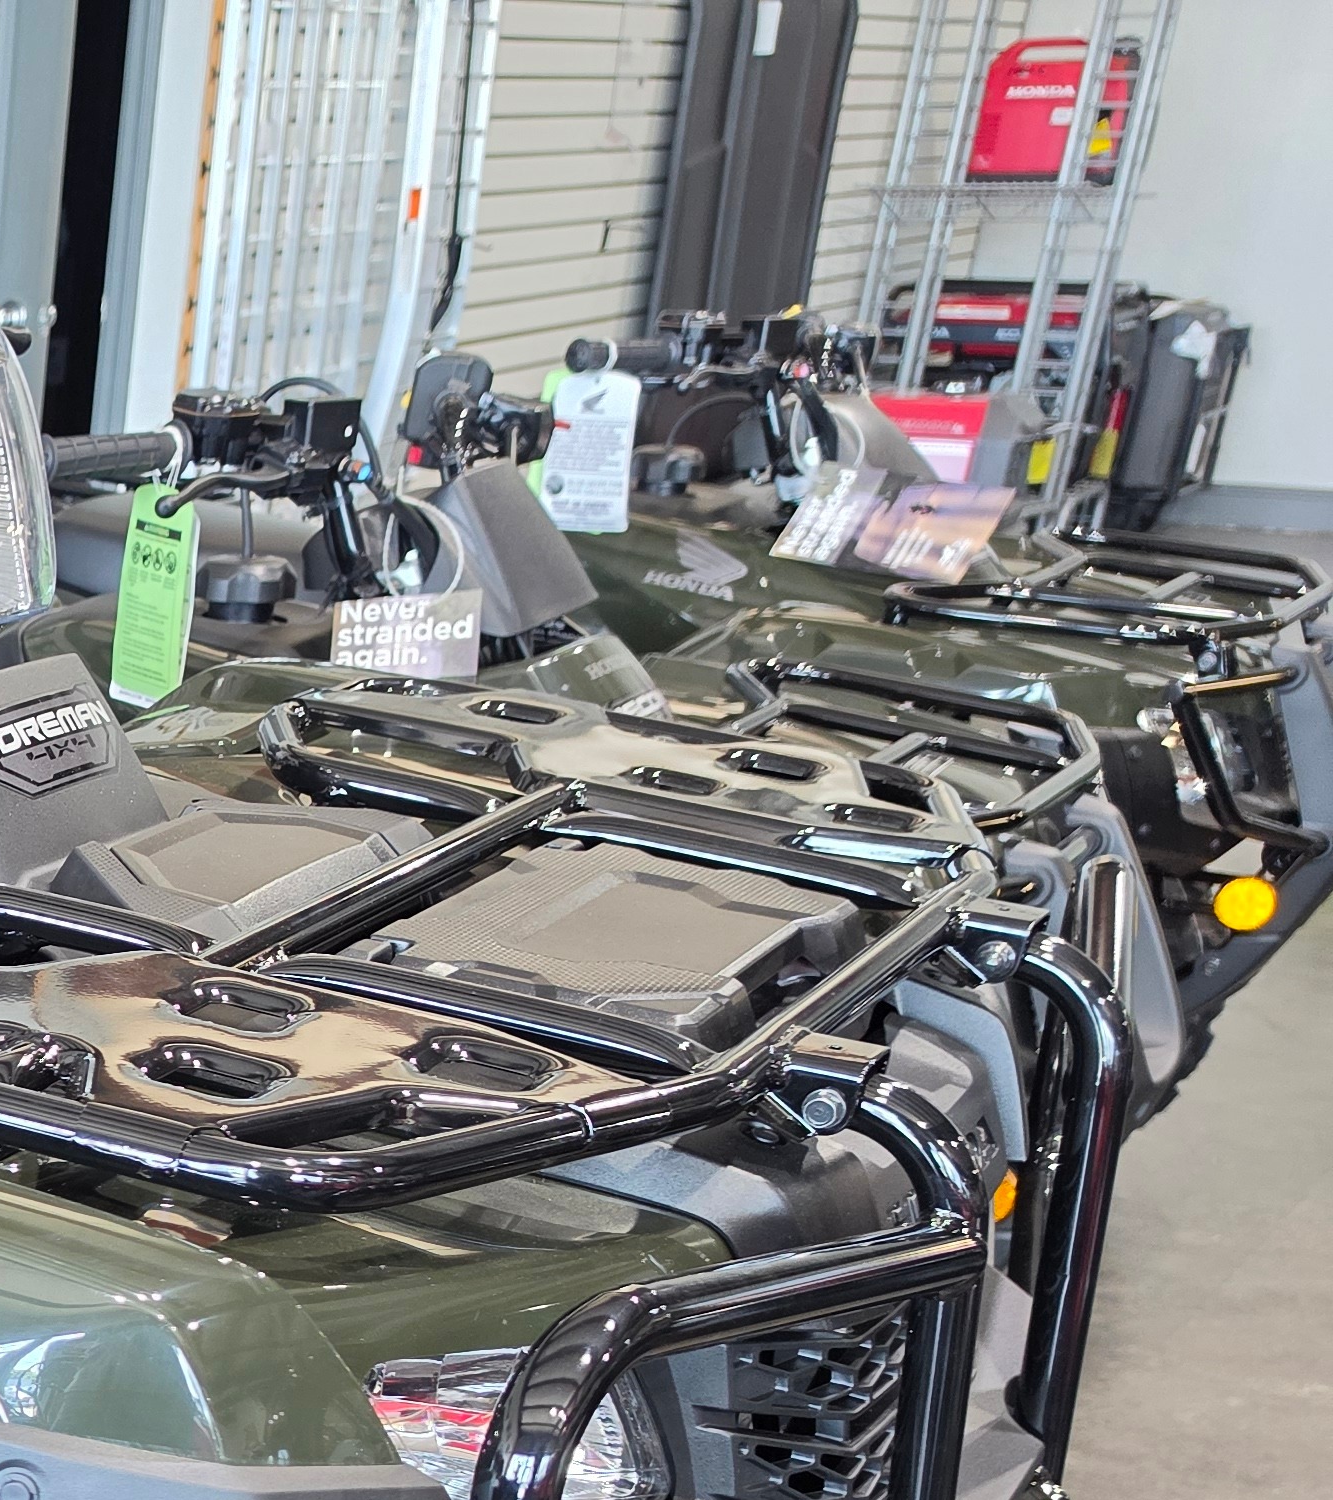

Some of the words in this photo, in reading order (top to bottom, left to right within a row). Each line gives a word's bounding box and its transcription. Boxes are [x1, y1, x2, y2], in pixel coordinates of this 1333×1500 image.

[1005, 85, 1076, 100] HONDA
[642, 569, 734, 602] HONDA
[340, 598, 431, 625] Never
[337, 613, 475, 647] stranded
[335, 643, 428, 669] again.
